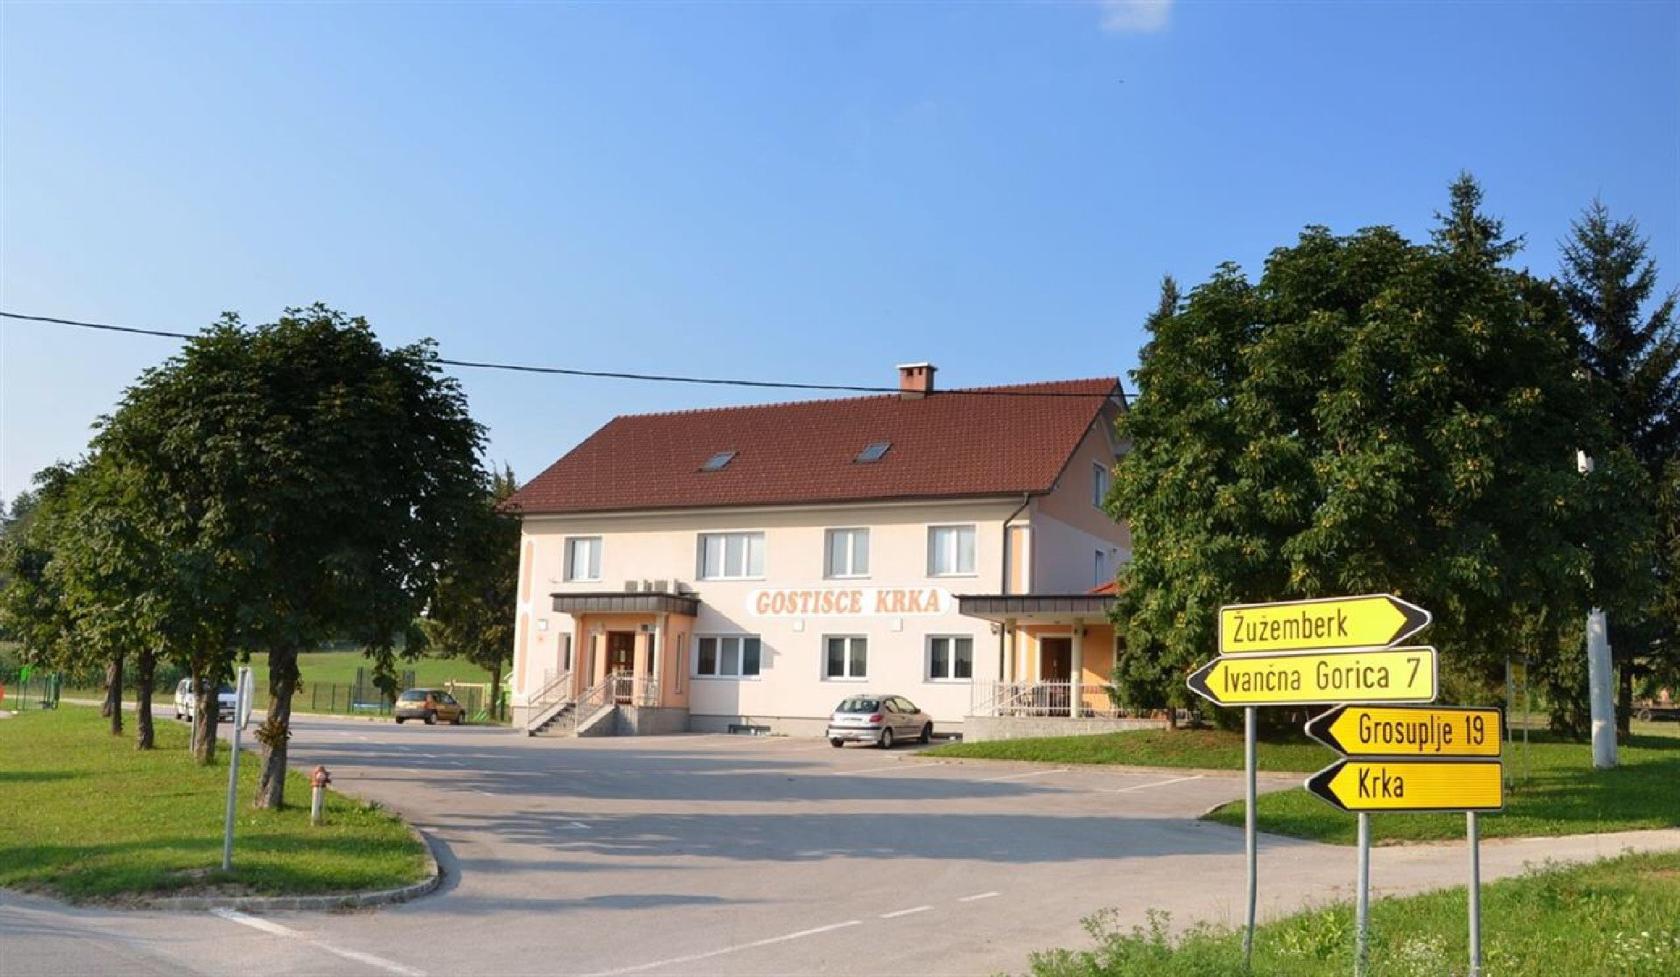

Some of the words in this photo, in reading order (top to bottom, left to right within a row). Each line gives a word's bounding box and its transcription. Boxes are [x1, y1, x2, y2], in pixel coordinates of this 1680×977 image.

[875, 589, 940, 613] KRKA
[1233, 608, 1348, 644] Žužemberk
[1223, 664, 1302, 693] Ivančna
[1316, 660, 1390, 690] Gorica
[1407, 658, 1421, 688] 7
[1359, 713, 1453, 752] Grosuplje
[1465, 715, 1484, 745] 19
[1358, 768, 1404, 798] Krka
